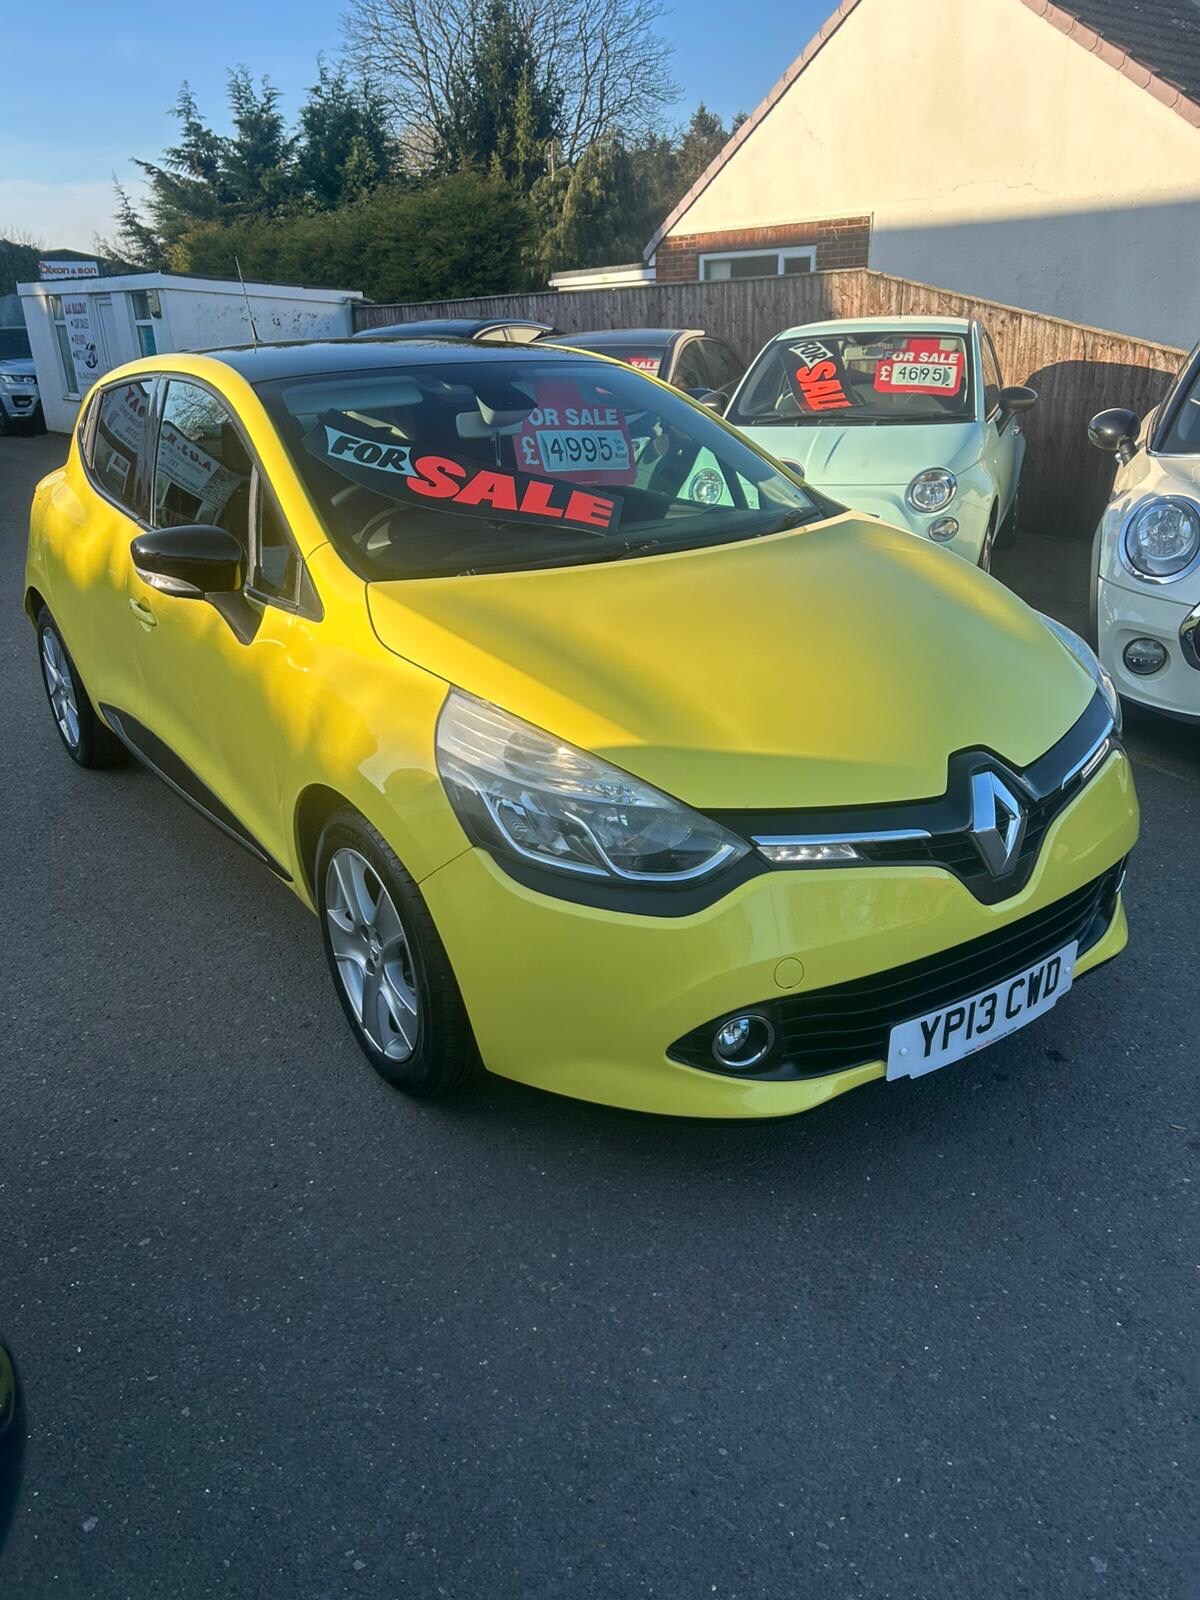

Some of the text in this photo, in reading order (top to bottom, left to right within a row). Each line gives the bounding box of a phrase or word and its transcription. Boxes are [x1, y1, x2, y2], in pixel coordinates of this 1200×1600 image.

[793, 342, 828, 363] FOR
[883, 351, 960, 364] FOR SALE
[796, 361, 853, 411] SAL
[880, 365, 943, 381] £ 4695
[523, 407, 619, 426] OR SALE
[331, 436, 408, 471] FOR
[521, 436, 540, 465] £
[550, 437, 613, 463] 4995
[406, 456, 614, 528] SALE
[920, 992, 998, 1058] YP13
[1005, 956, 1061, 1020] CWD
